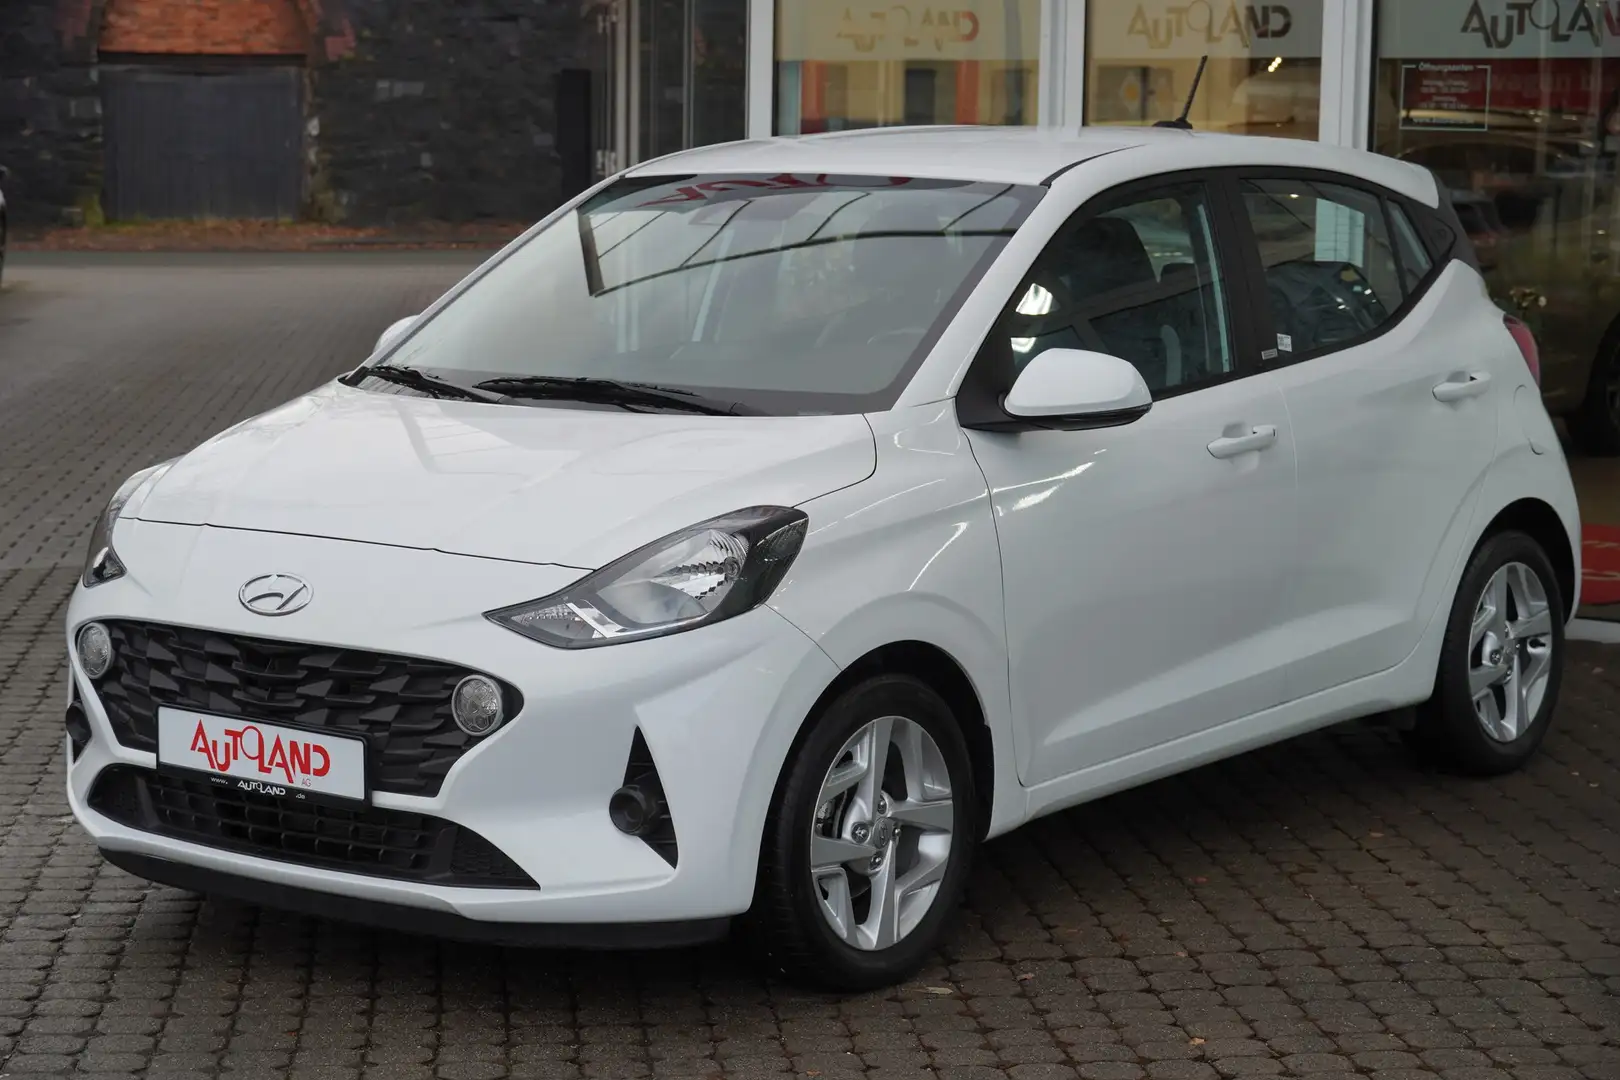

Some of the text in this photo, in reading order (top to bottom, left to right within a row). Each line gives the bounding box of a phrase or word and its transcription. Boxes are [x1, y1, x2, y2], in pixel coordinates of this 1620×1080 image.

[1127, 0, 1292, 49] AUTOLAND
[190, 718, 331, 784] AUTOLAND
[237, 779, 286, 796] AUTOLAND
[301, 777, 312, 788] AG
